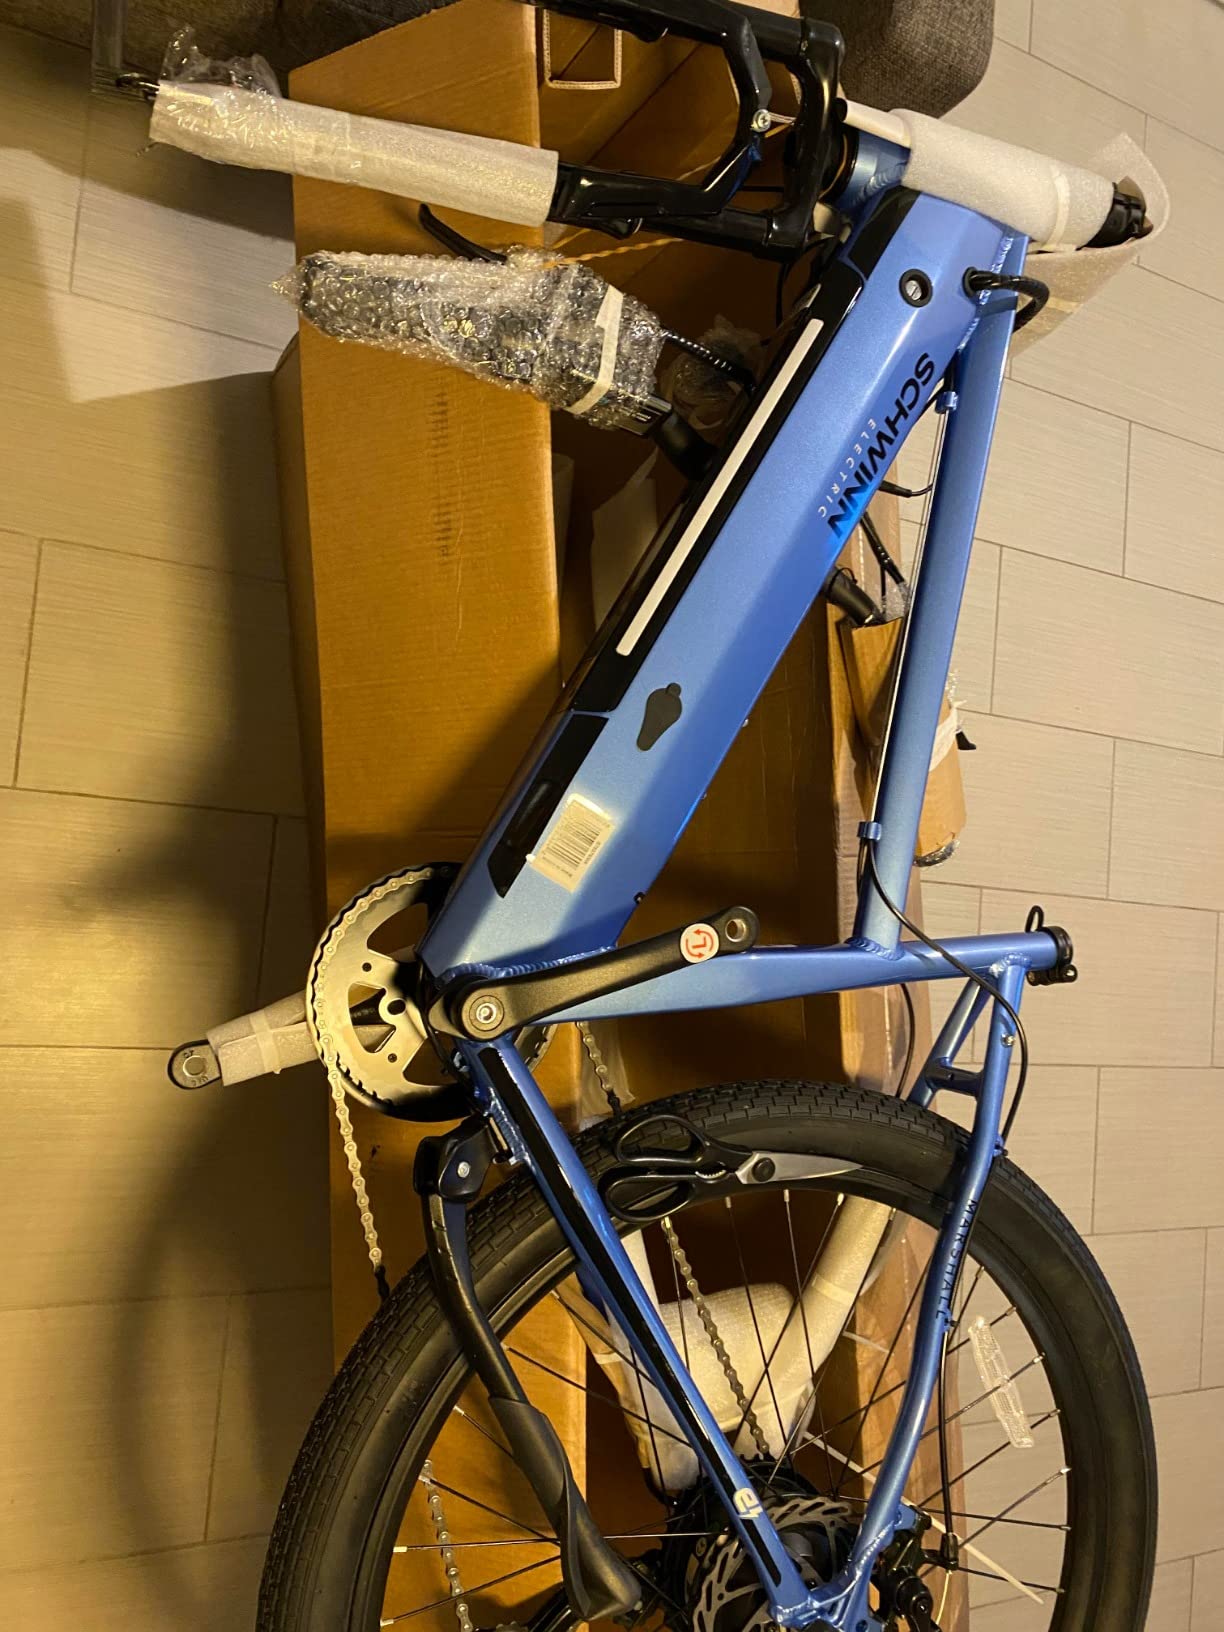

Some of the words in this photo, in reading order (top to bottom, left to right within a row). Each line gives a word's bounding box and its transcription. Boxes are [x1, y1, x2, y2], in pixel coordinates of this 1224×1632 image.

[818, 418, 877, 518] ELECTRIC
[827, 353, 935, 538] SCHWINN
[936, 1200, 978, 1319] MARSHALL
